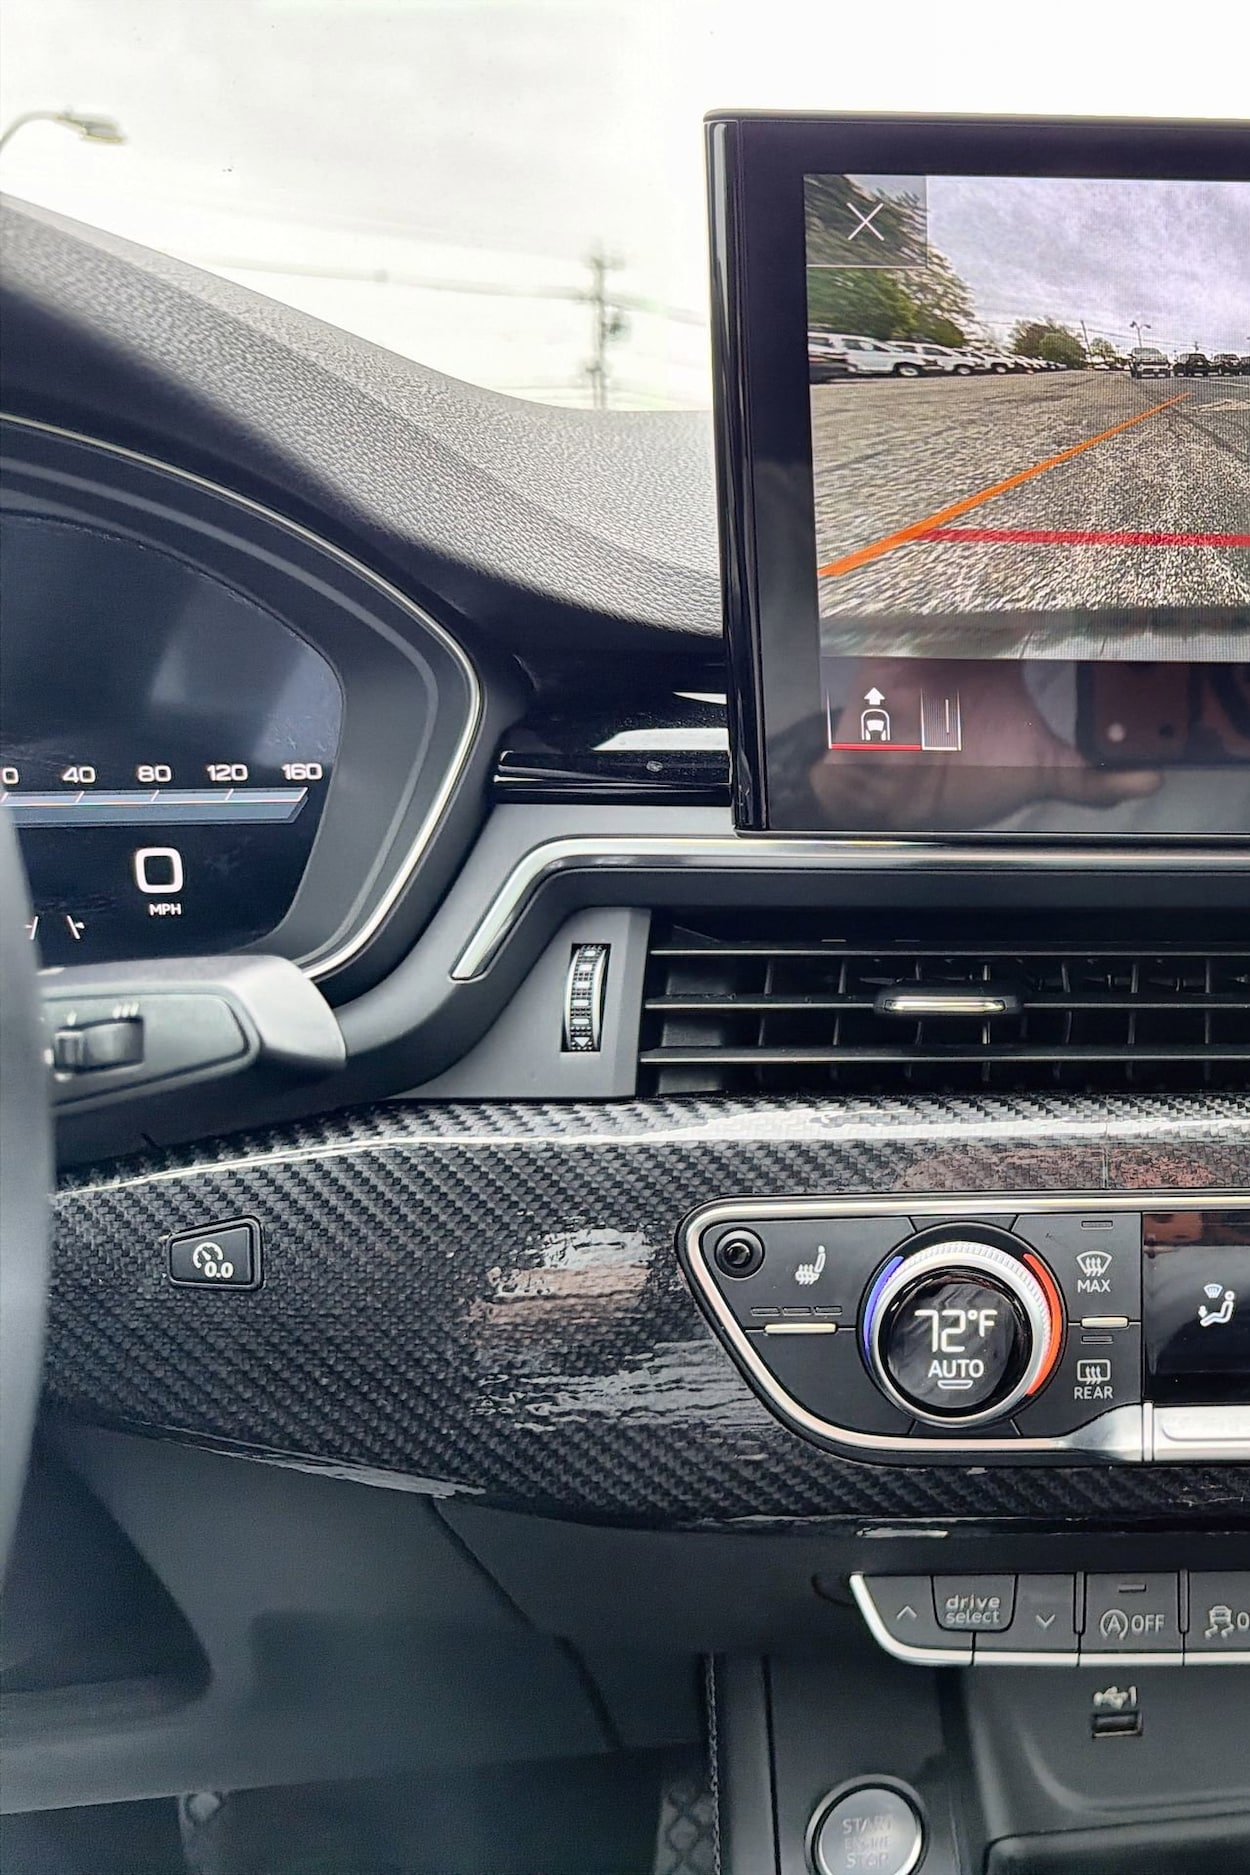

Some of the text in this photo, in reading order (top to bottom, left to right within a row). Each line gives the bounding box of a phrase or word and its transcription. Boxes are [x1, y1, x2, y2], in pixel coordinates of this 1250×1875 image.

[62, 766, 96, 783] 40
[138, 765, 171, 782] 80
[207, 764, 248, 782] 120
[281, 763, 323, 781] 160
[135, 847, 184, 894] 0
[149, 903, 182, 917] MPH
[204, 1261, 234, 1279] 0.0
[1077, 1281, 1111, 1294] MAX
[927, 1359, 984, 1378] AUTO
[1073, 1386, 1114, 1400] REAR
[945, 1594, 1001, 1610] drive
[945, 1608, 1000, 1624] select
[1131, 1613, 1165, 1634] OFF
